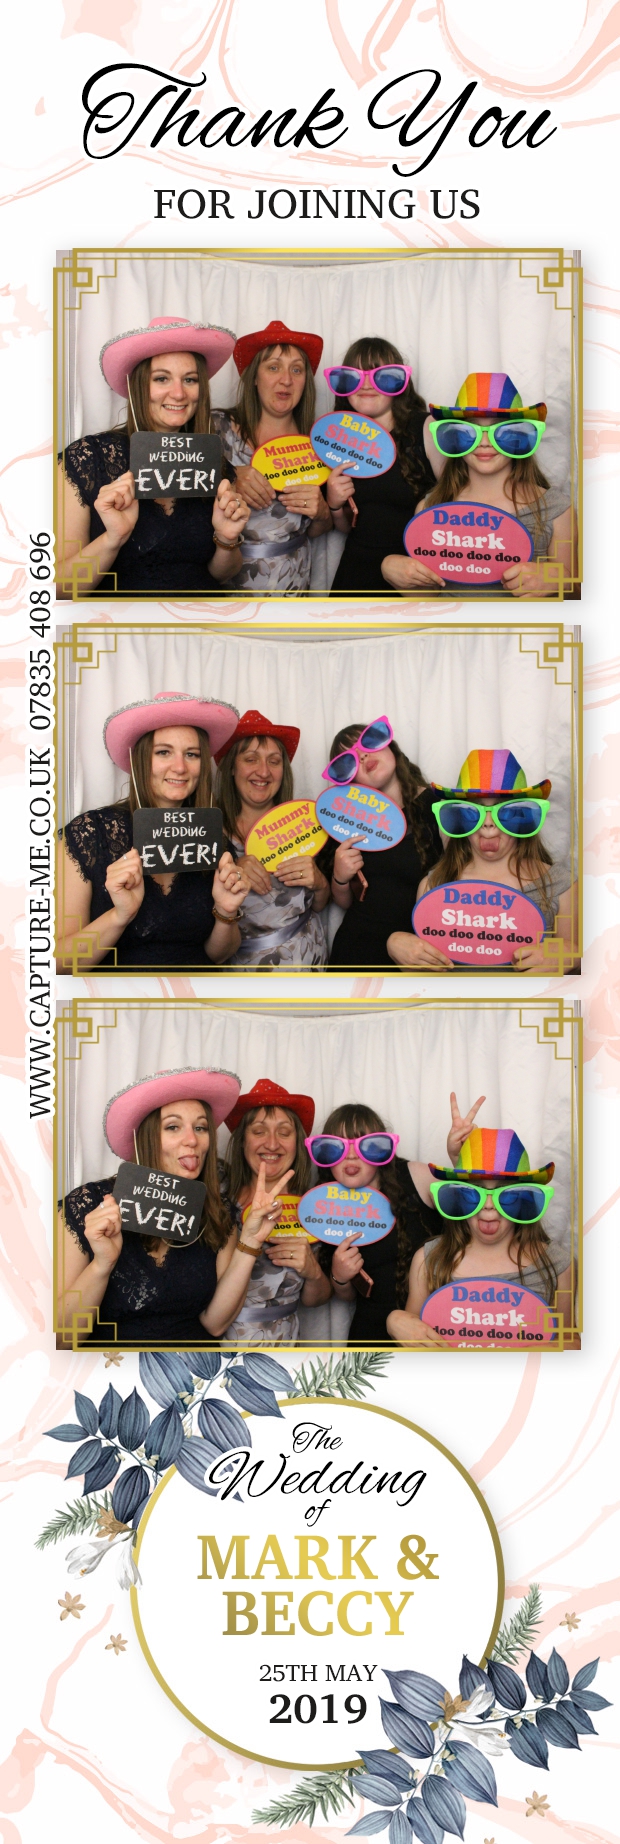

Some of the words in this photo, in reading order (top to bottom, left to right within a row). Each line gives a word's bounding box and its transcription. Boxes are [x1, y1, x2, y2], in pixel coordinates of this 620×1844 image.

[339, 413, 381, 441] Baby
[161, 436, 193, 448] BEST
[263, 442, 312, 458] Mumm
[325, 423, 383, 459] Shark
[314, 435, 329, 446] doo
[331, 442, 347, 453] doo
[348, 450, 364, 461] doo
[366, 458, 383, 469] doo
[325, 451, 342, 463] doo
[282, 469, 298, 477] doo
[317, 461, 327, 469] do
[303, 473, 319, 482] doo
[134, 468, 216, 492] EVER!
[433, 509, 504, 531] Daddy
[431, 529, 506, 550] Shark
[414, 547, 437, 557] doo
[439, 549, 463, 559] doo
[466, 551, 492, 561] doo
[495, 552, 521, 563] doo
[439, 562, 463, 572] doo
[466, 564, 491, 575] doo
[346, 786, 390, 814] Baby
[163, 811, 196, 823] BEST
[254, 802, 310, 840] Mummy
[331, 796, 392, 832] Shark
[266, 818, 315, 851] Shark
[319, 807, 336, 819] doo
[337, 815, 355, 827] doo
[356, 823, 374, 834] doo
[375, 830, 394, 842] doo
[332, 824, 350, 836] doo
[277, 843, 294, 855] doo
[295, 832, 311, 844] doo
[312, 825, 323, 834] do
[300, 841, 316, 854] doo
[140, 842, 218, 868] EVER!
[443, 888, 517, 910] Daddy
[441, 908, 518, 930] Shark
[422, 927, 446, 937] doo
[449, 929, 474, 939] doo
[477, 931, 503, 941] doo
[506, 933, 533, 944] doo
[448, 942, 473, 953] doo
[476, 944, 502, 956] doo
[147, 1172, 180, 1190] BEST
[326, 1186, 373, 1205] Baby
[119, 1198, 196, 1237] EVER!
[314, 1199, 382, 1220] Shark
[304, 1215, 324, 1224] doo
[325, 1217, 345, 1226] doo
[347, 1219, 366, 1228] doo
[368, 1220, 387, 1229] doo
[324, 1228, 344, 1237] doo
[451, 1286, 525, 1307] Daddy
[450, 1307, 528, 1327] Shark
[458, 1327, 483, 1338] doo
[486, 1329, 513, 1340] doo
[516, 1330, 544, 1341] doo
